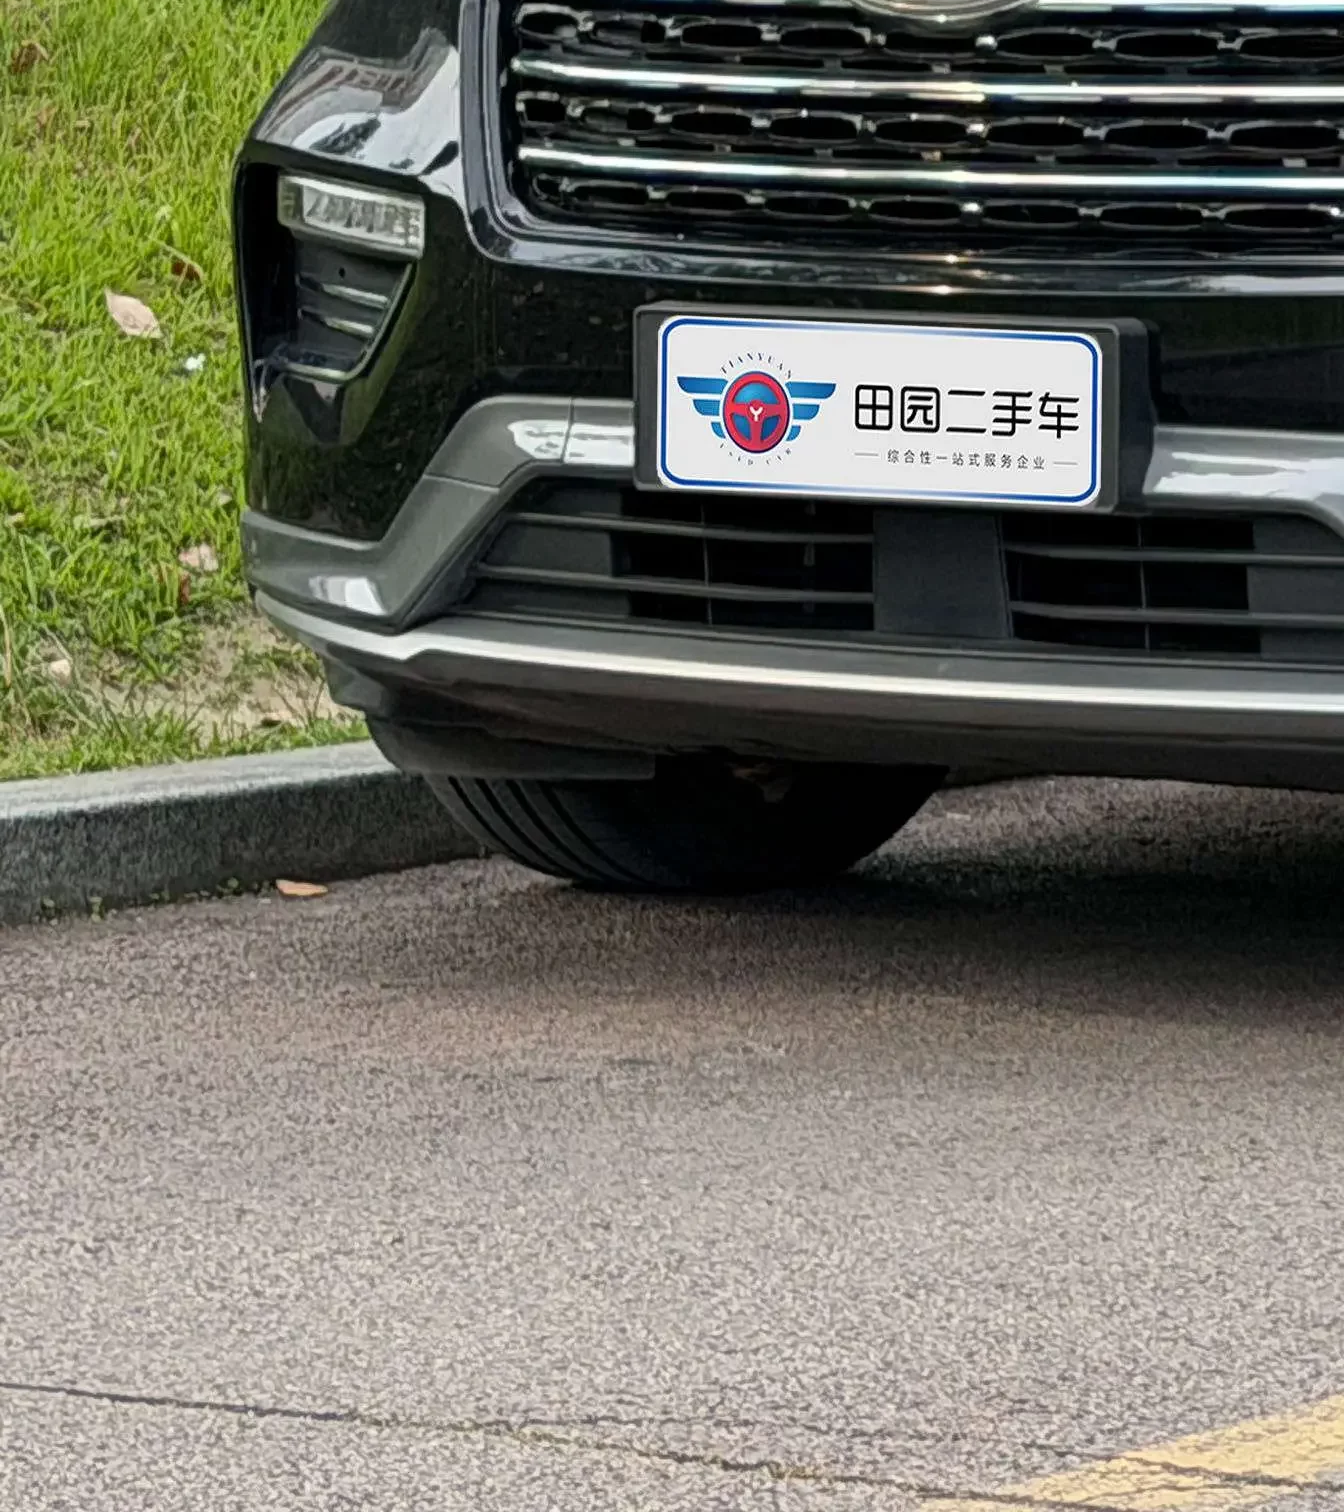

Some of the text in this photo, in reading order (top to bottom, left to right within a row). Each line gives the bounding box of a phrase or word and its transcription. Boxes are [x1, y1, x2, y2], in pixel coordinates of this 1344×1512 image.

[854, 384, 1080, 439] 田园二手车
[887, 448, 1046, 471] 综合性一站式服务企业
